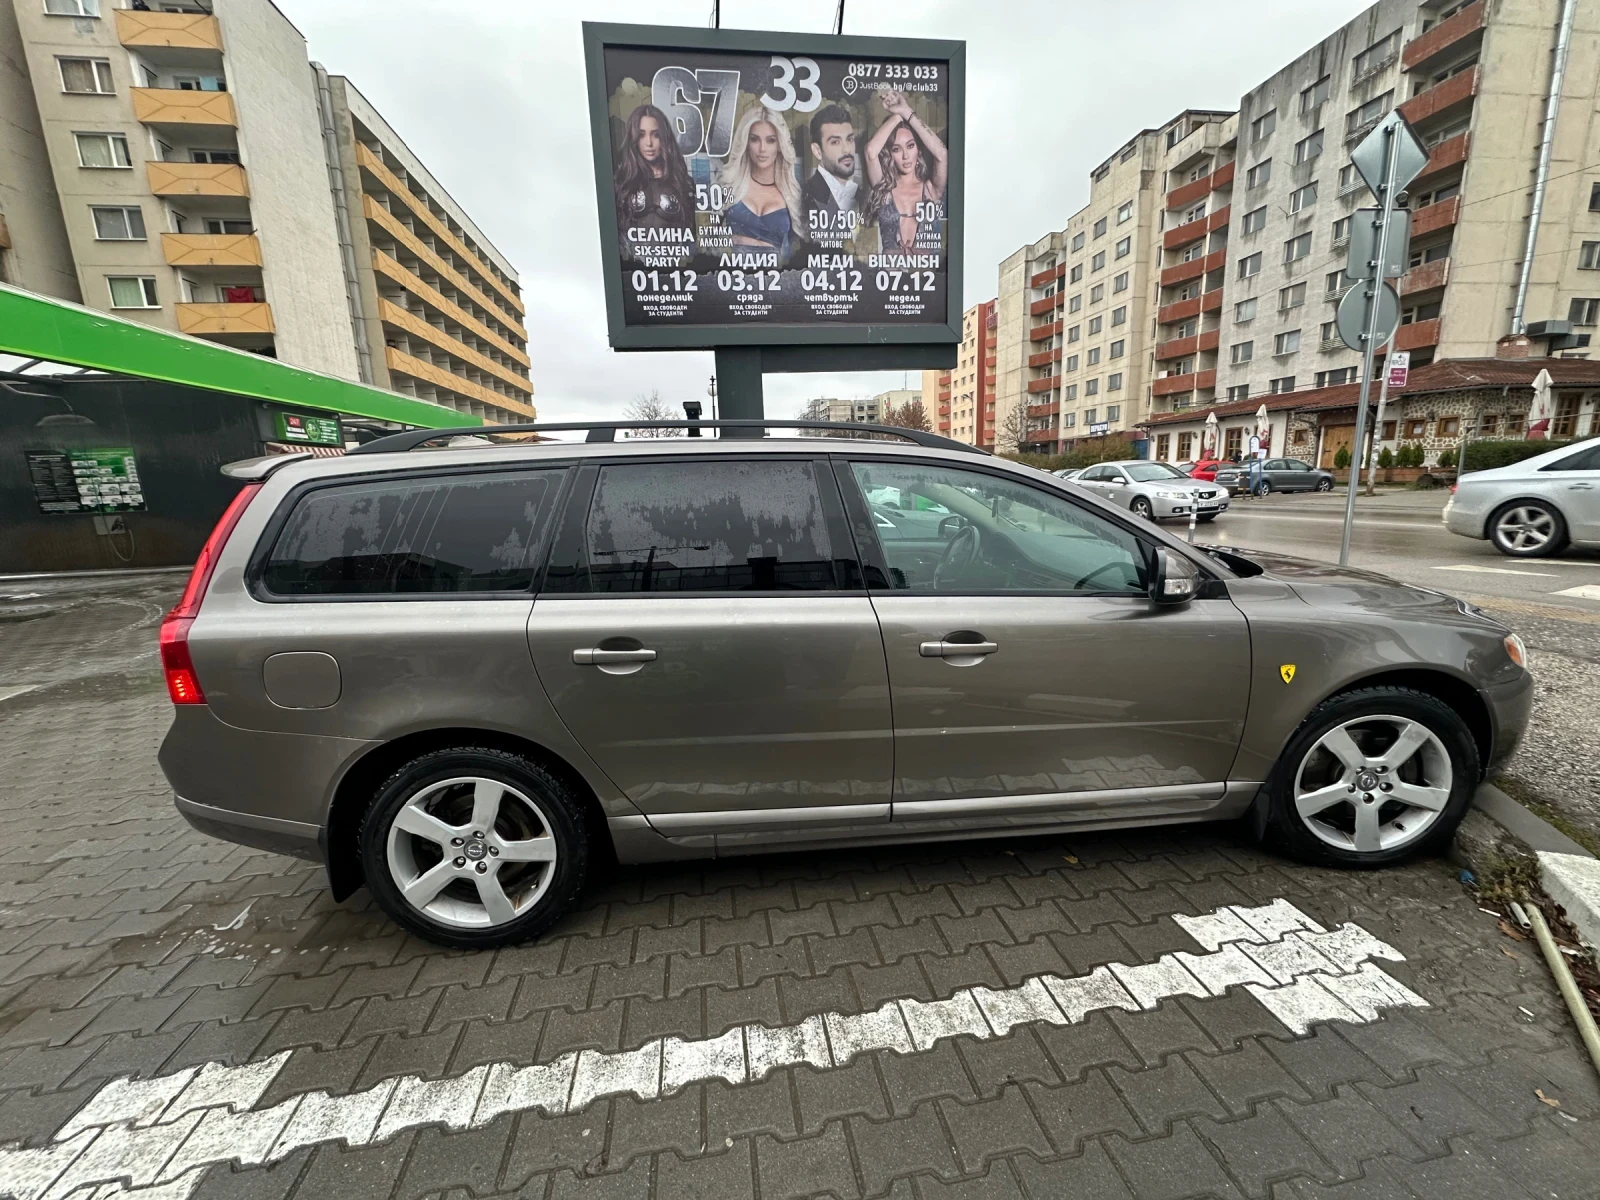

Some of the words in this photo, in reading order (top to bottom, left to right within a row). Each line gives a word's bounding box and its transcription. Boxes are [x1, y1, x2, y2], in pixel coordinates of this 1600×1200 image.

[849, 63, 881, 77] 0877
[885, 65, 909, 78] 333
[914, 66, 938, 79] 033
[760, 56, 822, 112] 33
[651, 66, 740, 158] 67
[696, 184, 734, 210] 50%
[710, 215, 720, 223] НА
[916, 202, 943, 222] 50%
[809, 210, 864, 230] 50/50%
[628, 228, 694, 242] СЕЛИНА
[699, 226, 733, 236] БУТИЛКА
[700, 238, 733, 247] АЛКОХОЛ
[635, 246, 689, 256] SIX-SEVEN
[646, 257, 680, 267] PARTY
[720, 253, 777, 270] ЛИДИЯ
[808, 255, 854, 270] МЕДИ
[869, 255, 939, 268] BILYANISH
[632, 270, 698, 291] 01.12
[717, 270, 782, 291] 03.12
[801, 271, 862, 291] 04.12
[876, 271, 936, 291] 07.12
[637, 293, 693, 302] понеделник
[737, 294, 763, 302] сряда
[804, 293, 858, 302] четвъртък
[889, 295, 920, 303] неделя
